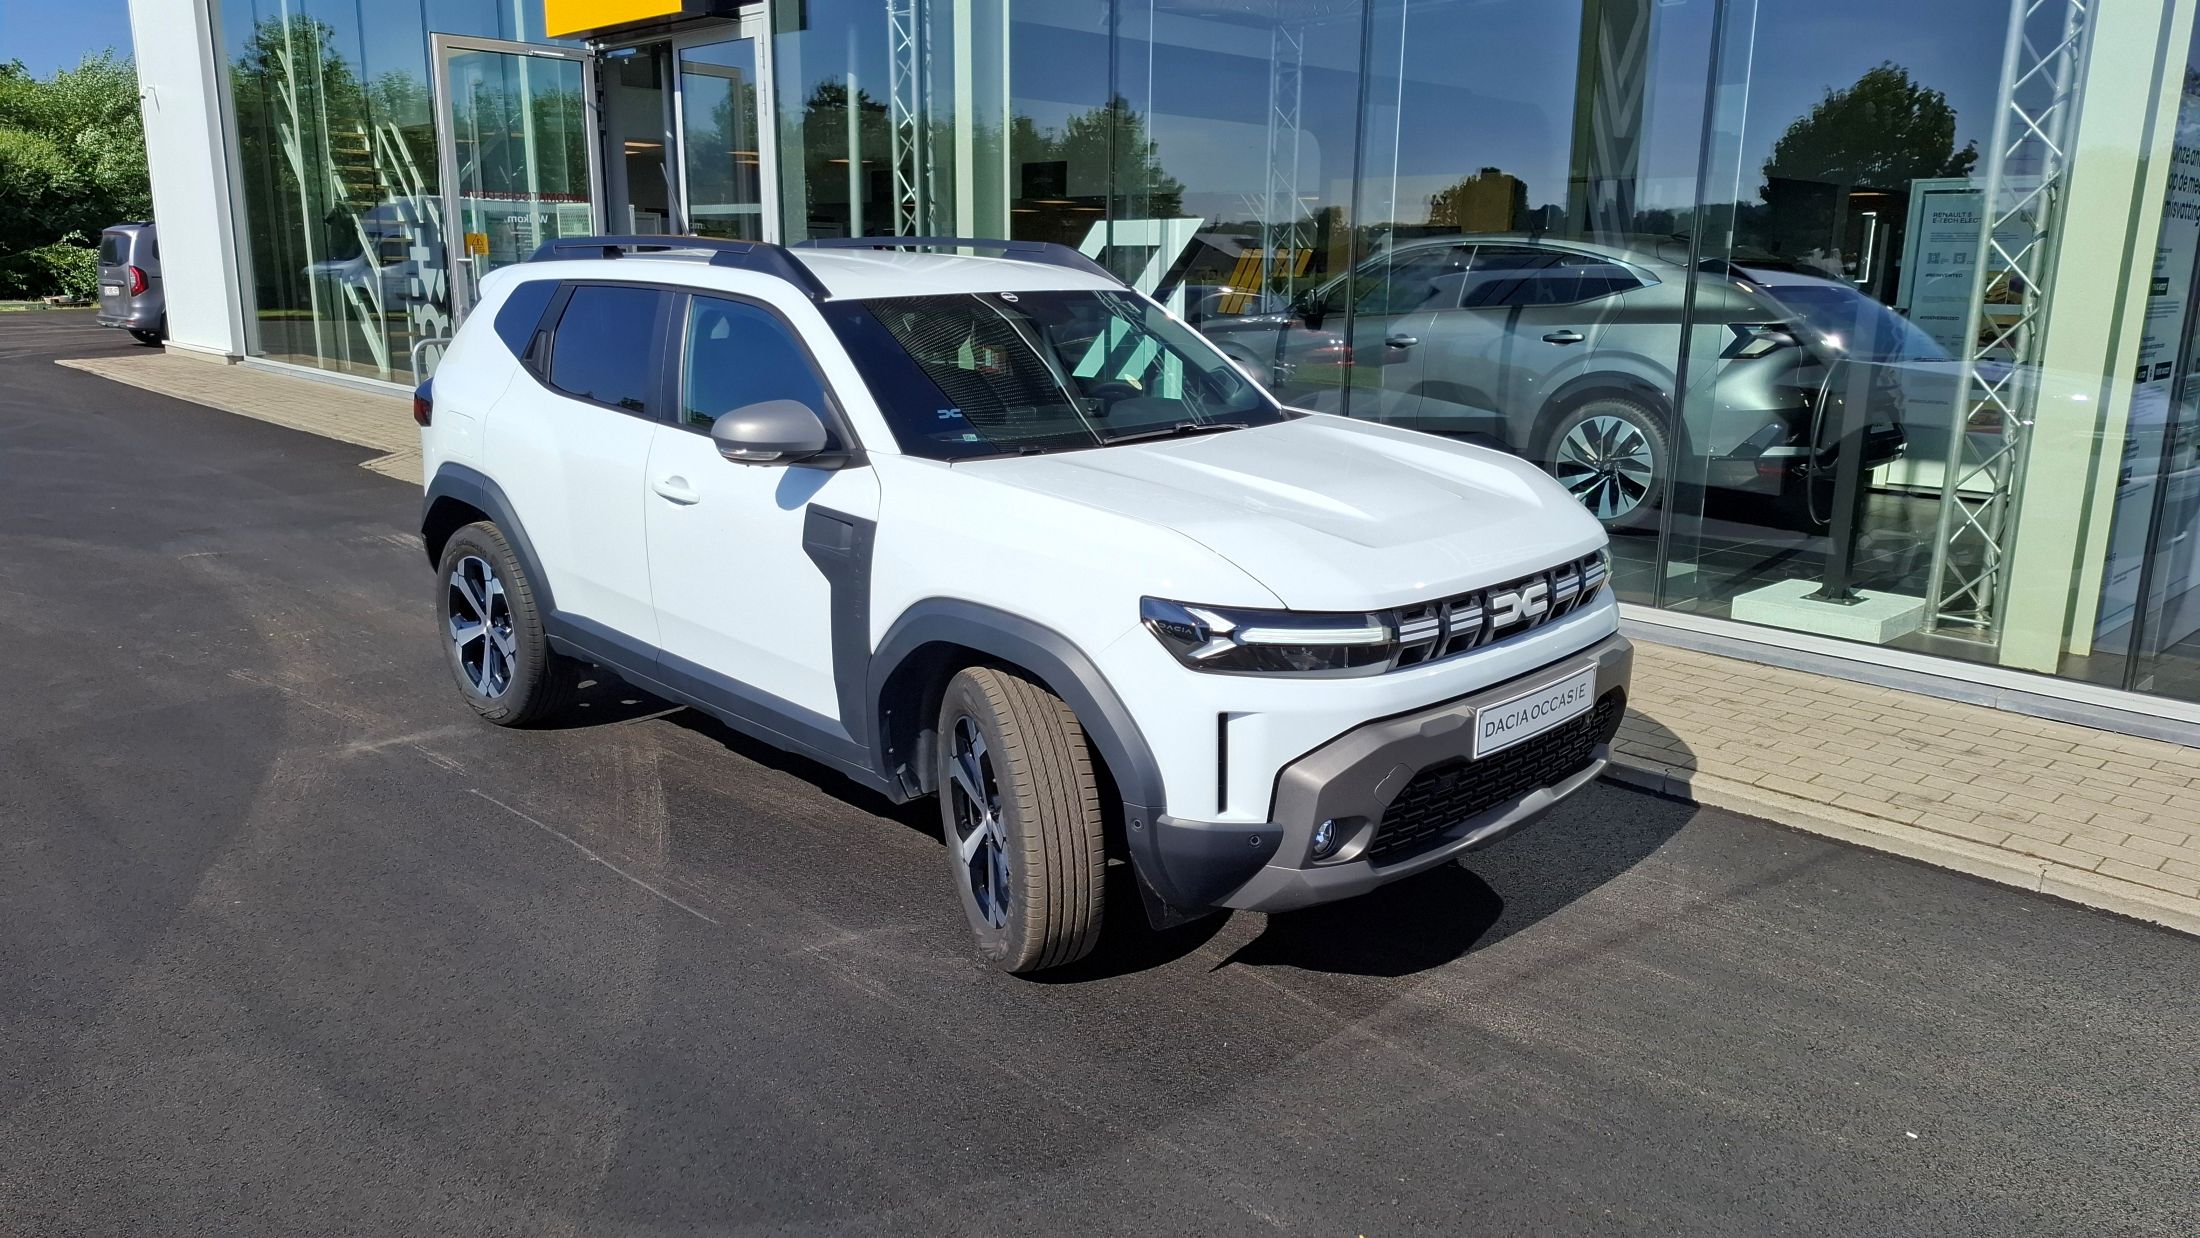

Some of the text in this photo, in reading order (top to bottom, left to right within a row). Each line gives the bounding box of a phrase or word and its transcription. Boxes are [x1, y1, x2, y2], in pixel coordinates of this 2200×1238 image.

[1159, 622, 1192, 635] DACIA
[1484, 683, 1586, 738] DACIA OCCASIE
